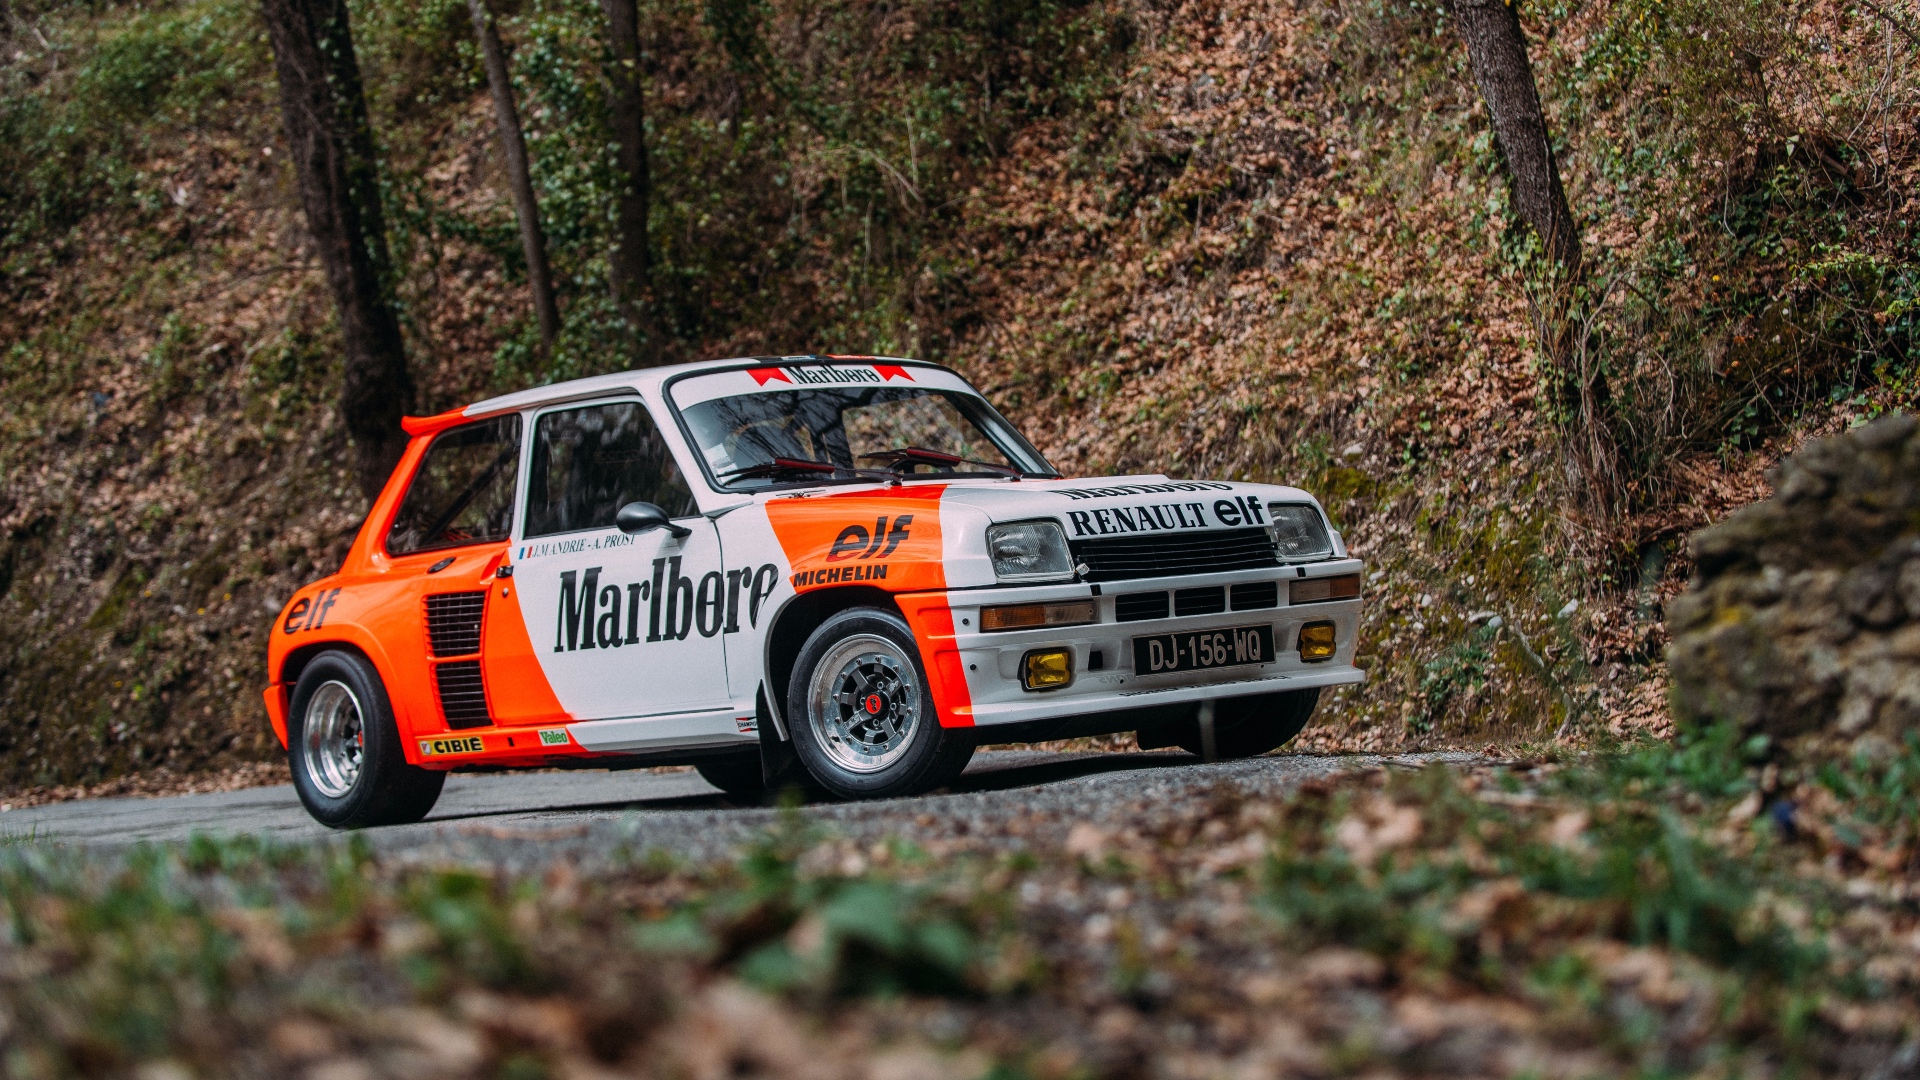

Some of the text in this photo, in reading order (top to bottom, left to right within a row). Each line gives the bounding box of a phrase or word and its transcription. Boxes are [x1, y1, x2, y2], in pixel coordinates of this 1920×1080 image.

[784, 364, 881, 385] Marlboro
[1065, 495, 1265, 537] RENAULT elf
[603, 534, 636, 549] PROST
[825, 514, 914, 563] elf
[793, 564, 888, 588] MICHELIN
[283, 586, 342, 635] elf
[553, 555, 779, 652] Marlboro
[1148, 629, 1261, 671] DJ-156-WQ
[539, 730, 568, 745] Valeo
